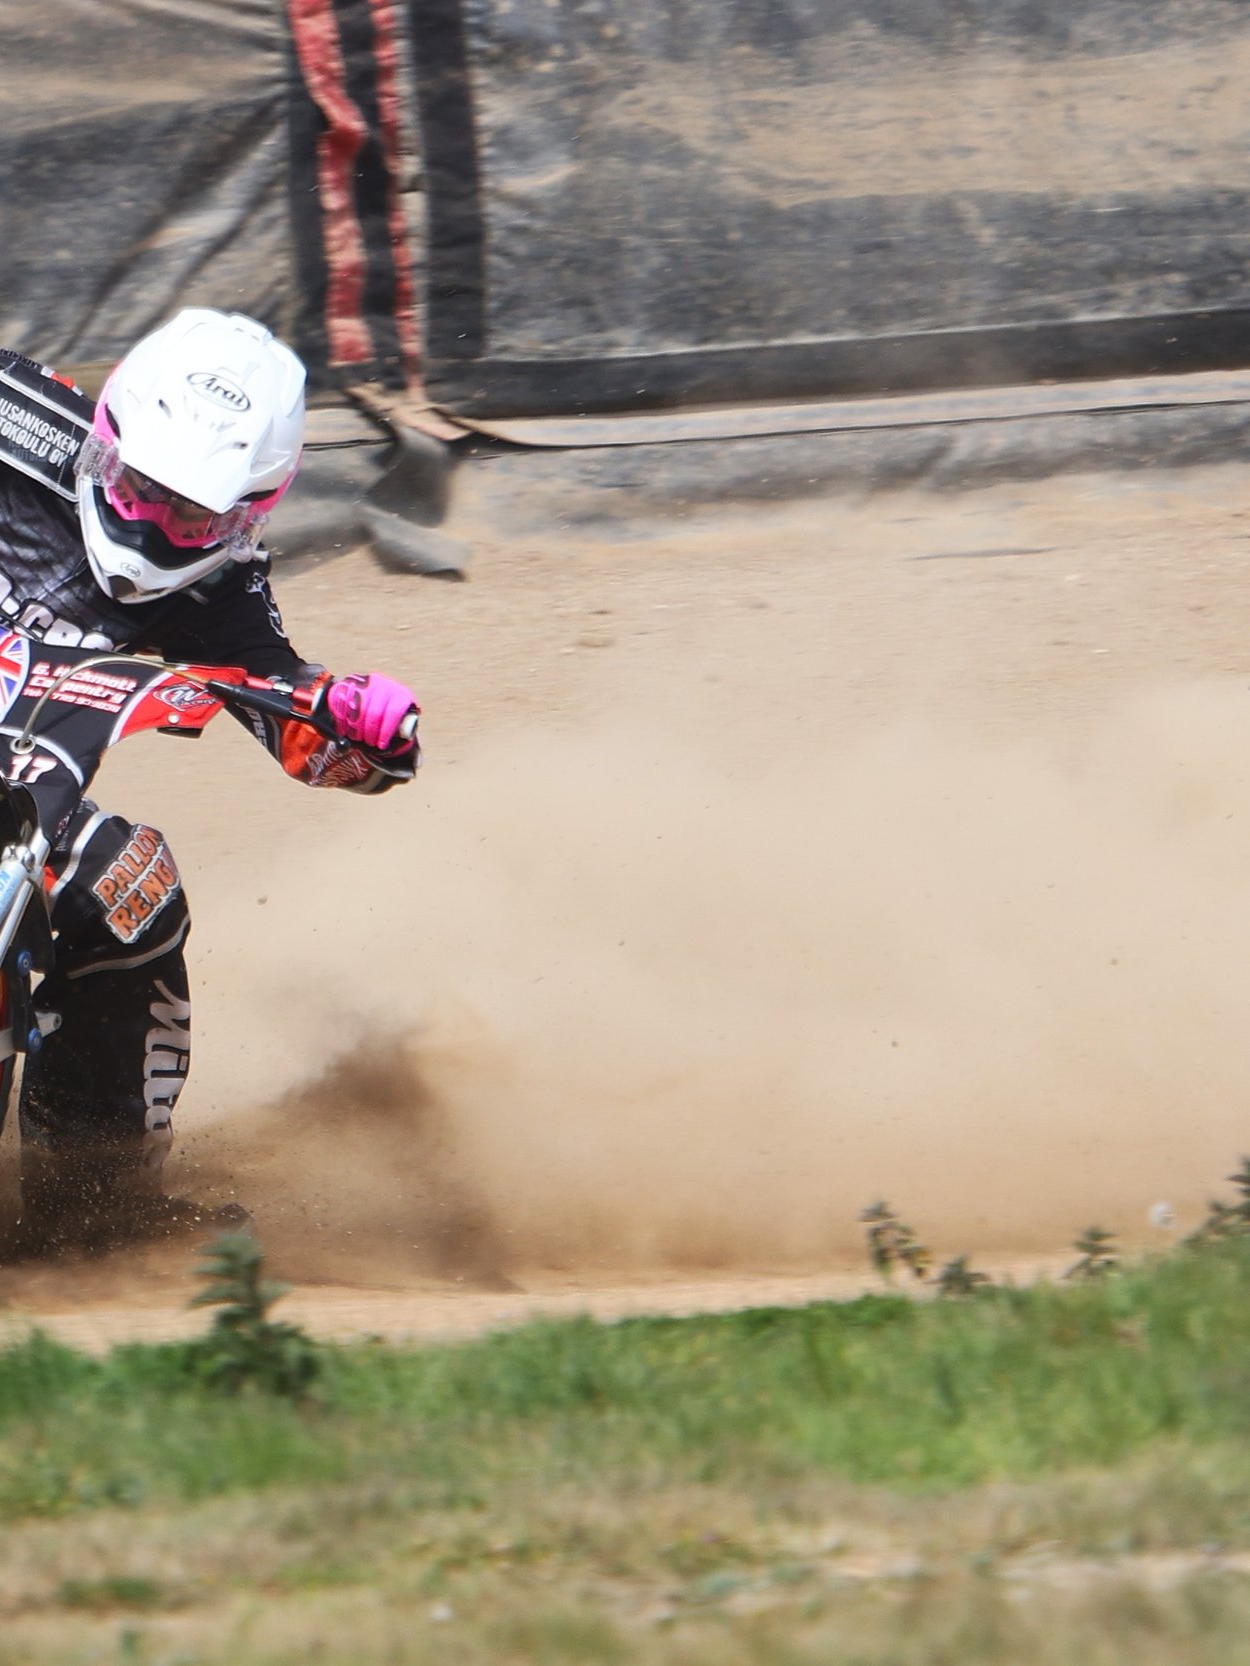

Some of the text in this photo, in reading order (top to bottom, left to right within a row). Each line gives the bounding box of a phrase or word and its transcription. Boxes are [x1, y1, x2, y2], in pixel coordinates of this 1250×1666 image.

[191, 376, 246, 407] Arai
[49, 448, 69, 468] OY
[29, 675, 128, 704] Capentry
[52, 664, 138, 693] Hckmott
